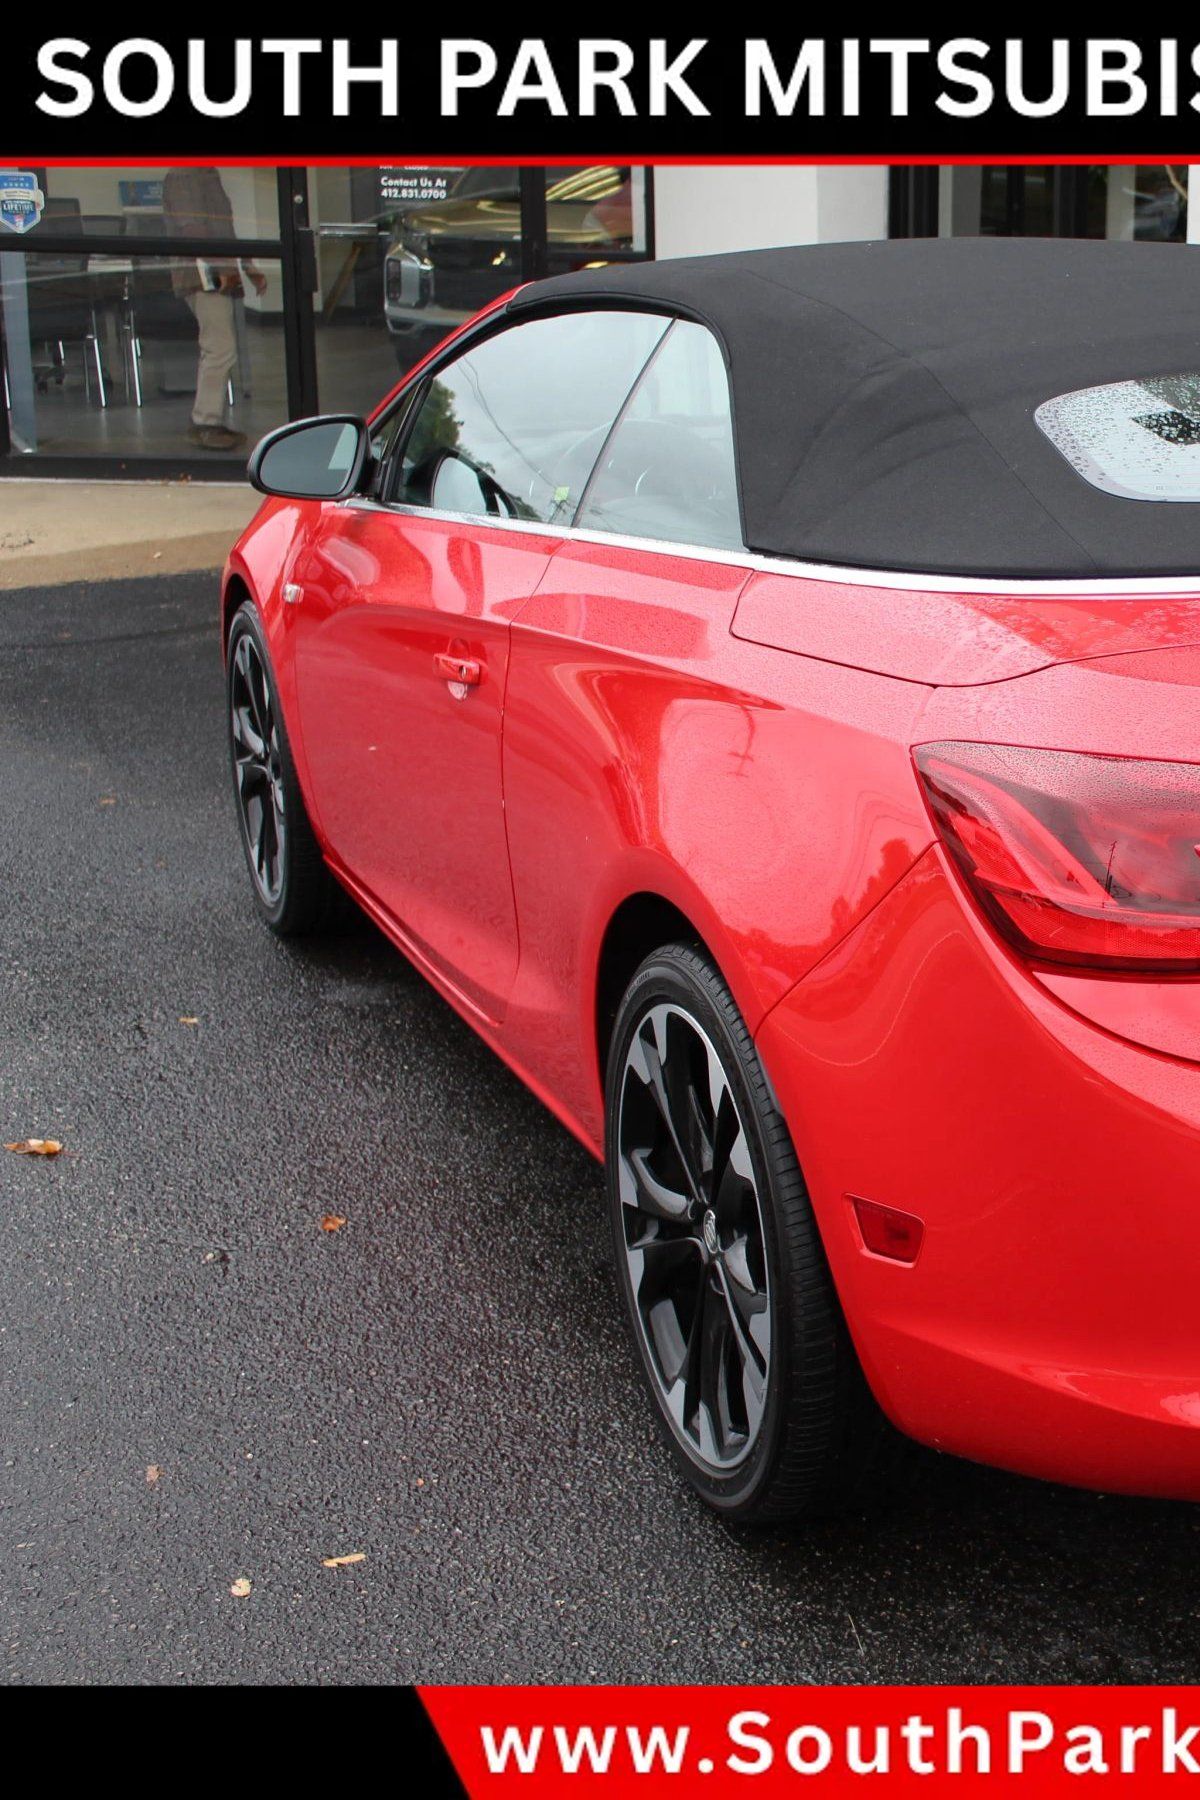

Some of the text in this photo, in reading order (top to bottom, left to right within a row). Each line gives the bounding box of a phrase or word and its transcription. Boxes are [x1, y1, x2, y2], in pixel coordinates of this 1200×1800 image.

[380, 176, 447, 188] Contact Us At
[380, 187, 447, 200] 412.831.0700
